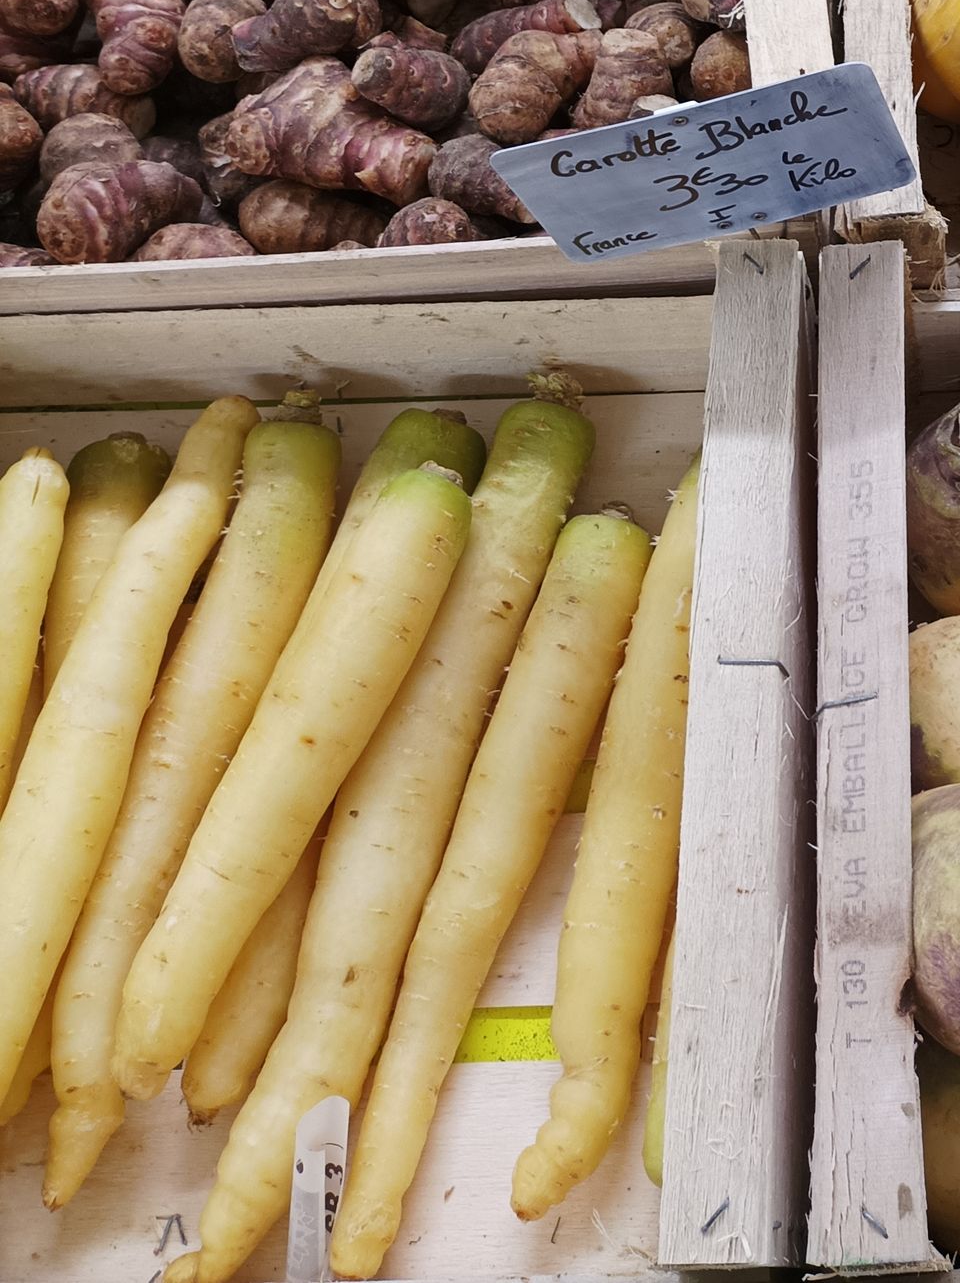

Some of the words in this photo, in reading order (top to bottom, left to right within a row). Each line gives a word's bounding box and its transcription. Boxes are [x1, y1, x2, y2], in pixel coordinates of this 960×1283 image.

[550, 128, 682, 177] Carotte
[694, 90, 848, 162] Blanche
[789, 158, 857, 191] Kilo
[572, 230, 659, 256] France
[841, 960, 868, 1009] 130
